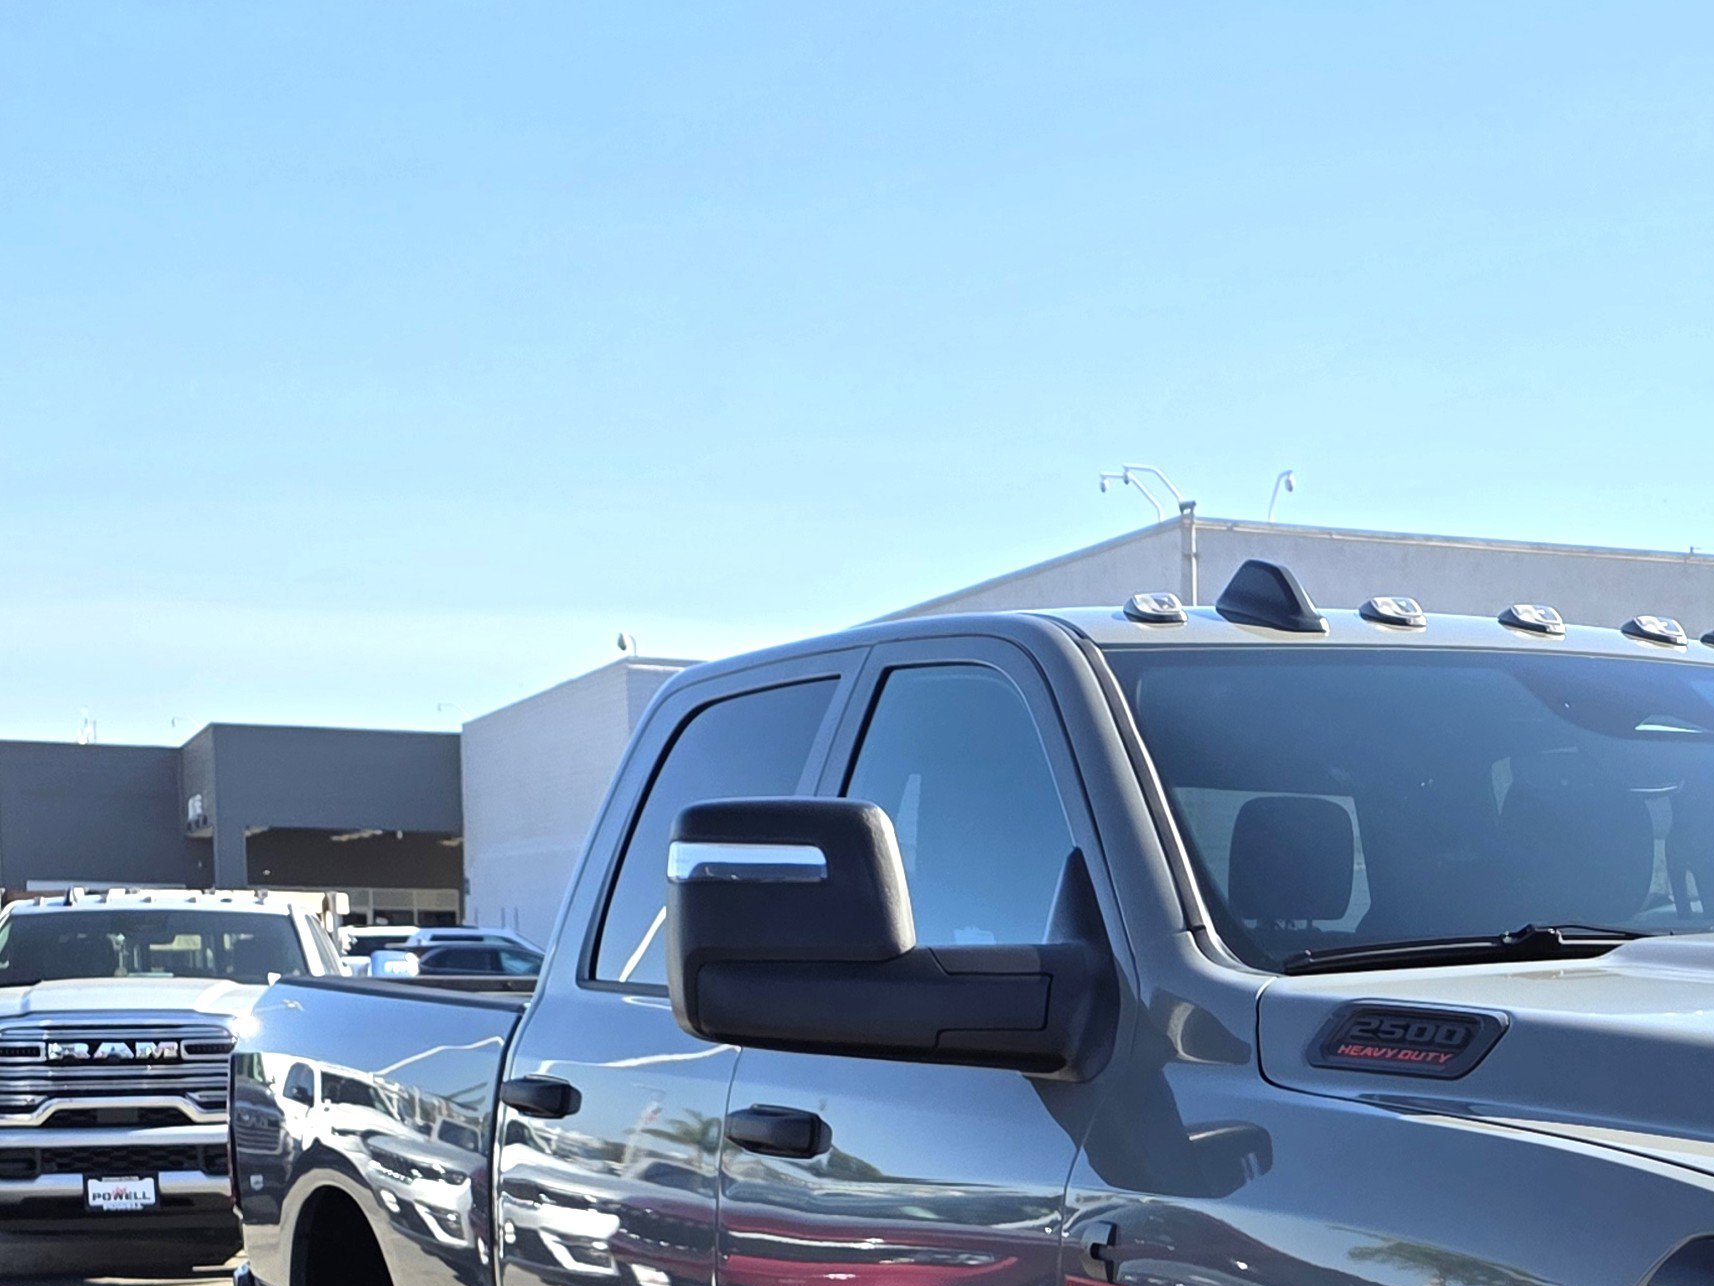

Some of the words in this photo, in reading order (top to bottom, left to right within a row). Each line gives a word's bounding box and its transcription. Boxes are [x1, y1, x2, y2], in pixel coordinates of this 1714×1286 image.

[1351, 1016, 1468, 1046] 2500
[48, 1041, 179, 1060] RAM
[1337, 1044, 1397, 1060] HEAVY
[1397, 1049, 1454, 1065] DUTY
[92, 1190, 151, 1201] POWELL
